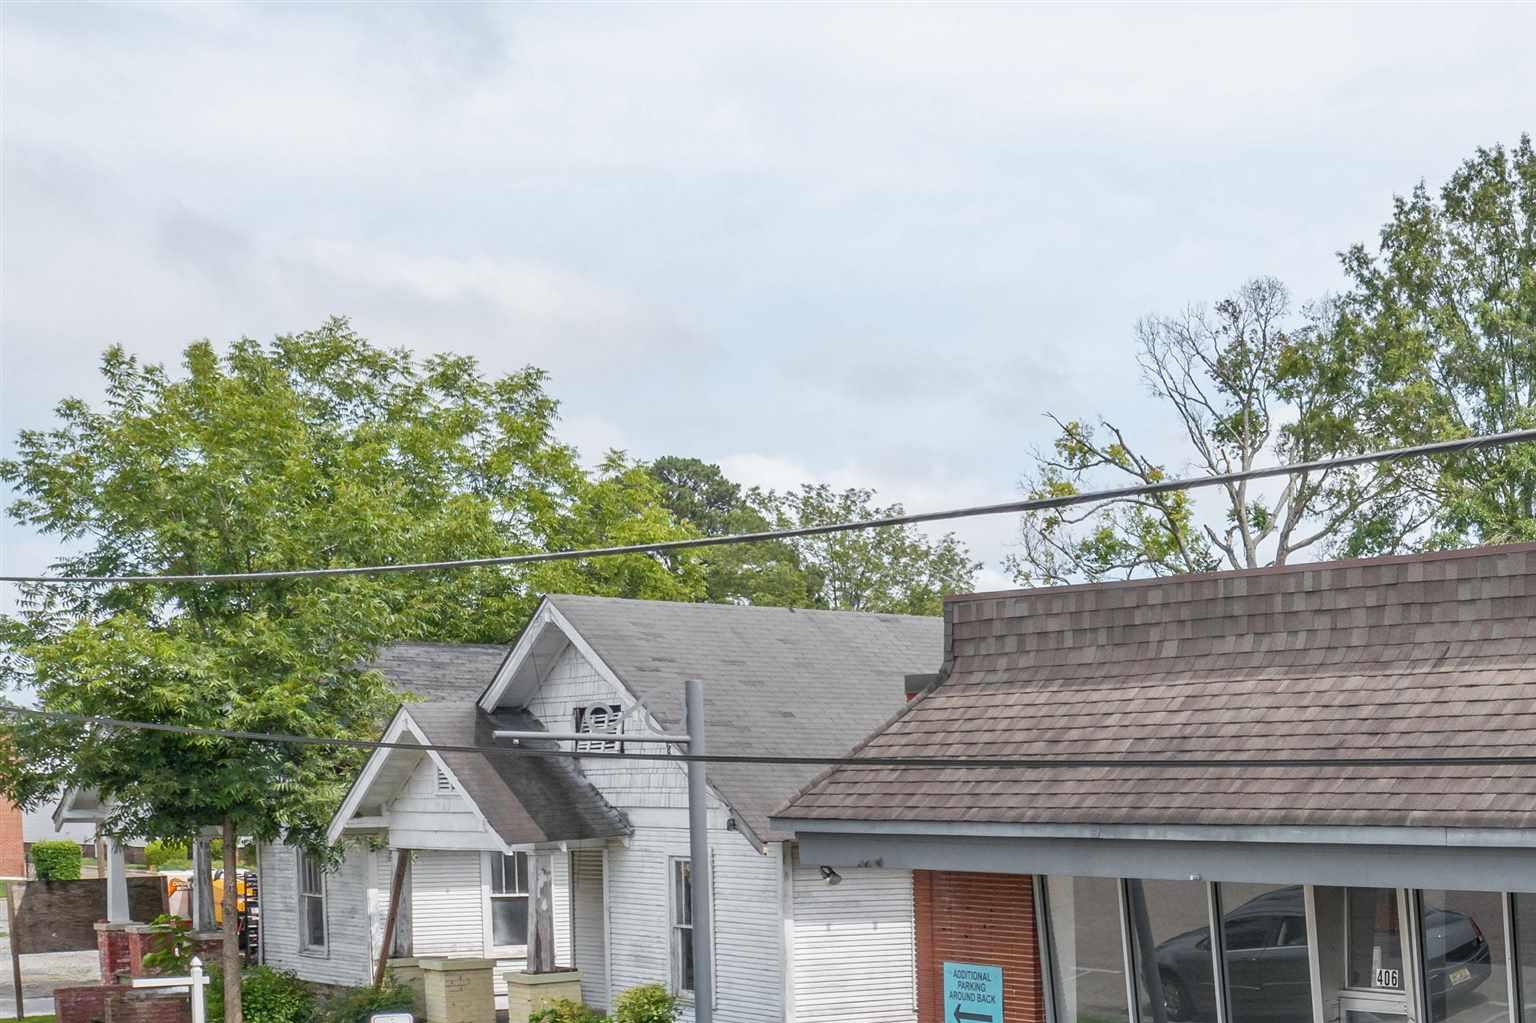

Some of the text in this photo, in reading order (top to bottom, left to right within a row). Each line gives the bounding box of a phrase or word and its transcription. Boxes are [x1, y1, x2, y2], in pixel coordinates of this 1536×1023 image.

[952, 969, 993, 982] ADDITIONAL
[1377, 970, 1398, 986] 406
[957, 980, 987, 993] PARKING
[949, 990, 997, 1004] AROUND BACK
